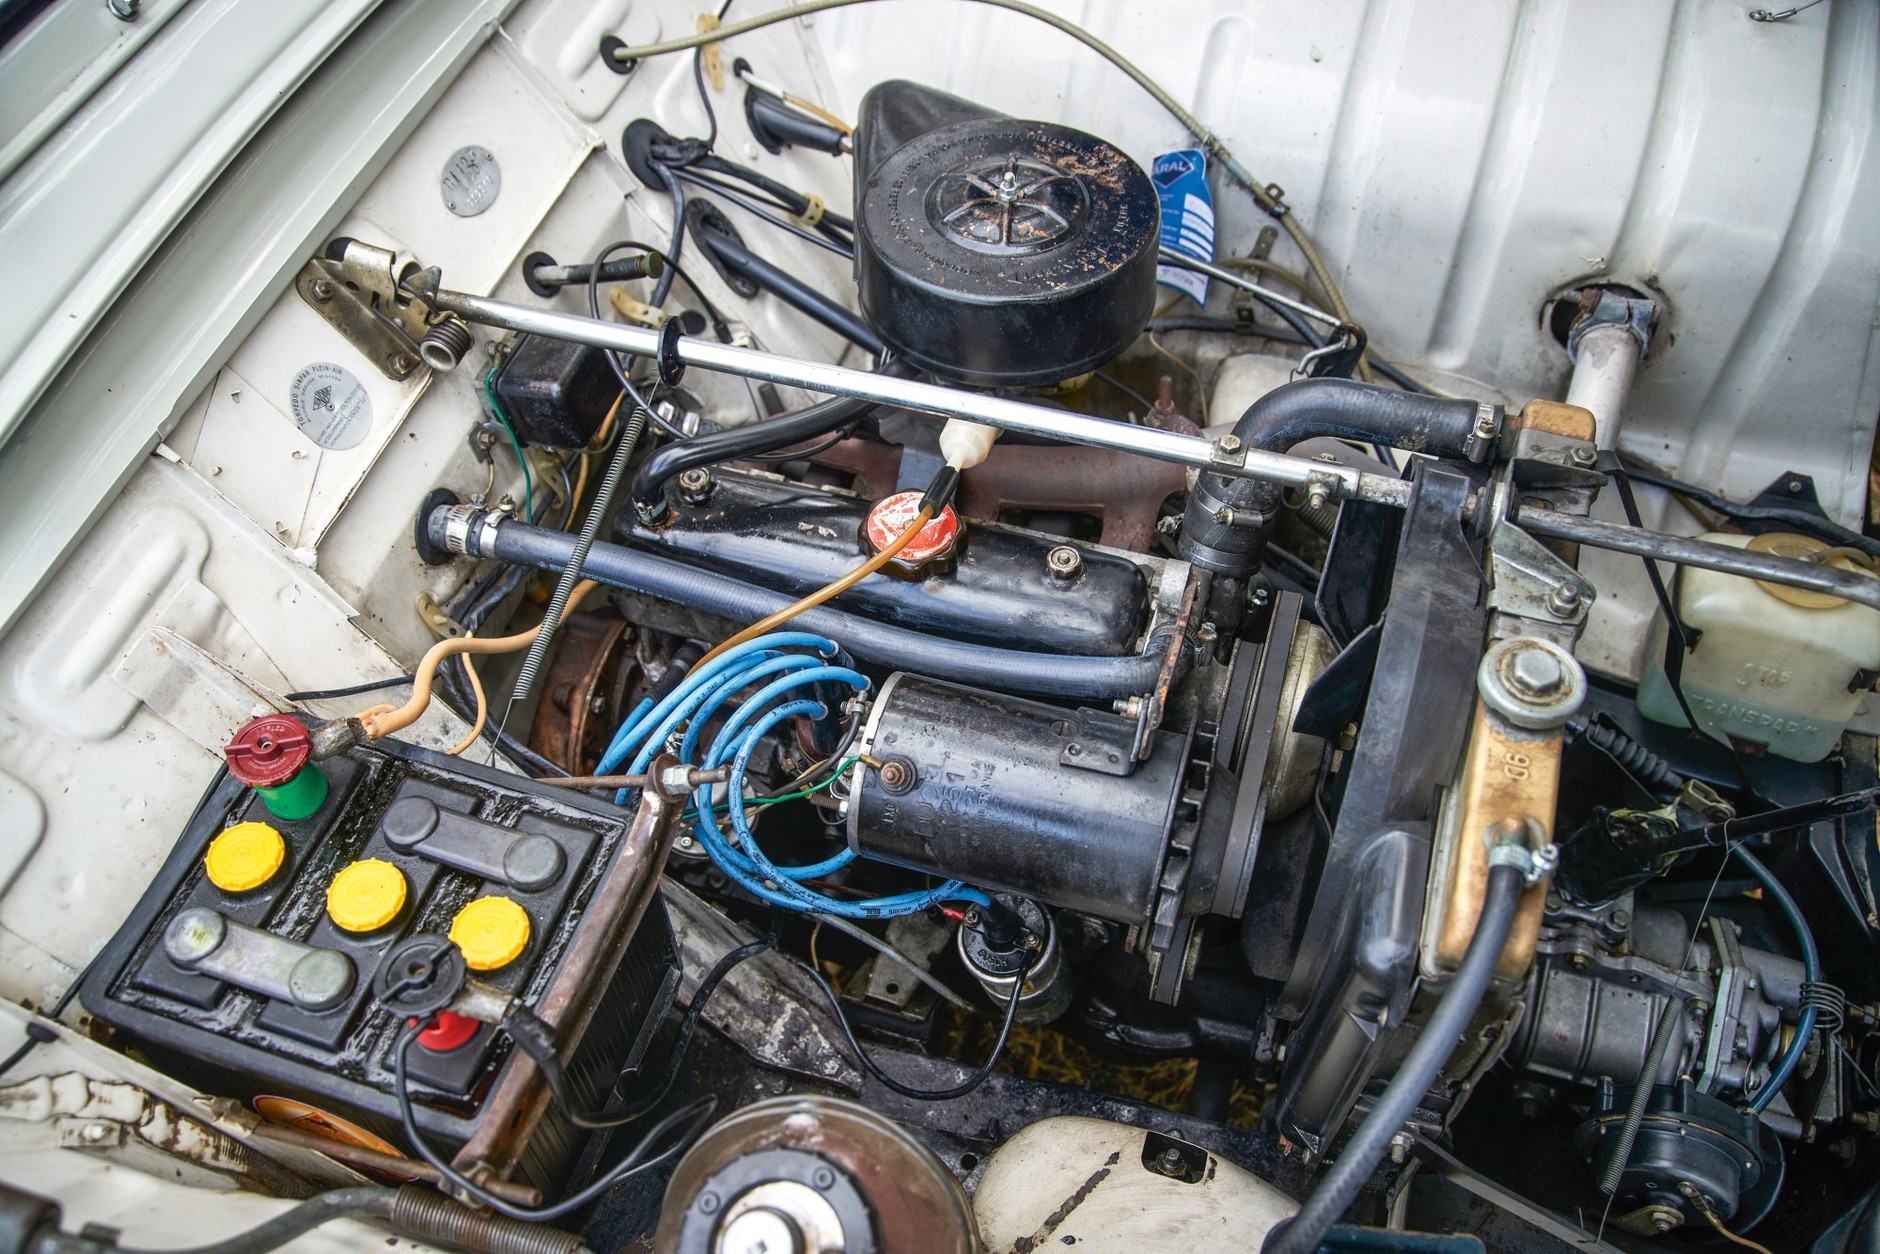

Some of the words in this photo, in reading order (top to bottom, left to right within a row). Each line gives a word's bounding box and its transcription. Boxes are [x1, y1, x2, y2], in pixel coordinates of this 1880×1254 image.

[1152, 161, 1187, 175] ARAL
[312, 365, 342, 375] PLEIN-AIR
[294, 370, 311, 390] SINPAR
[292, 393, 306, 427] TORPEDO
[978, 949, 1007, 967] BOSCH
